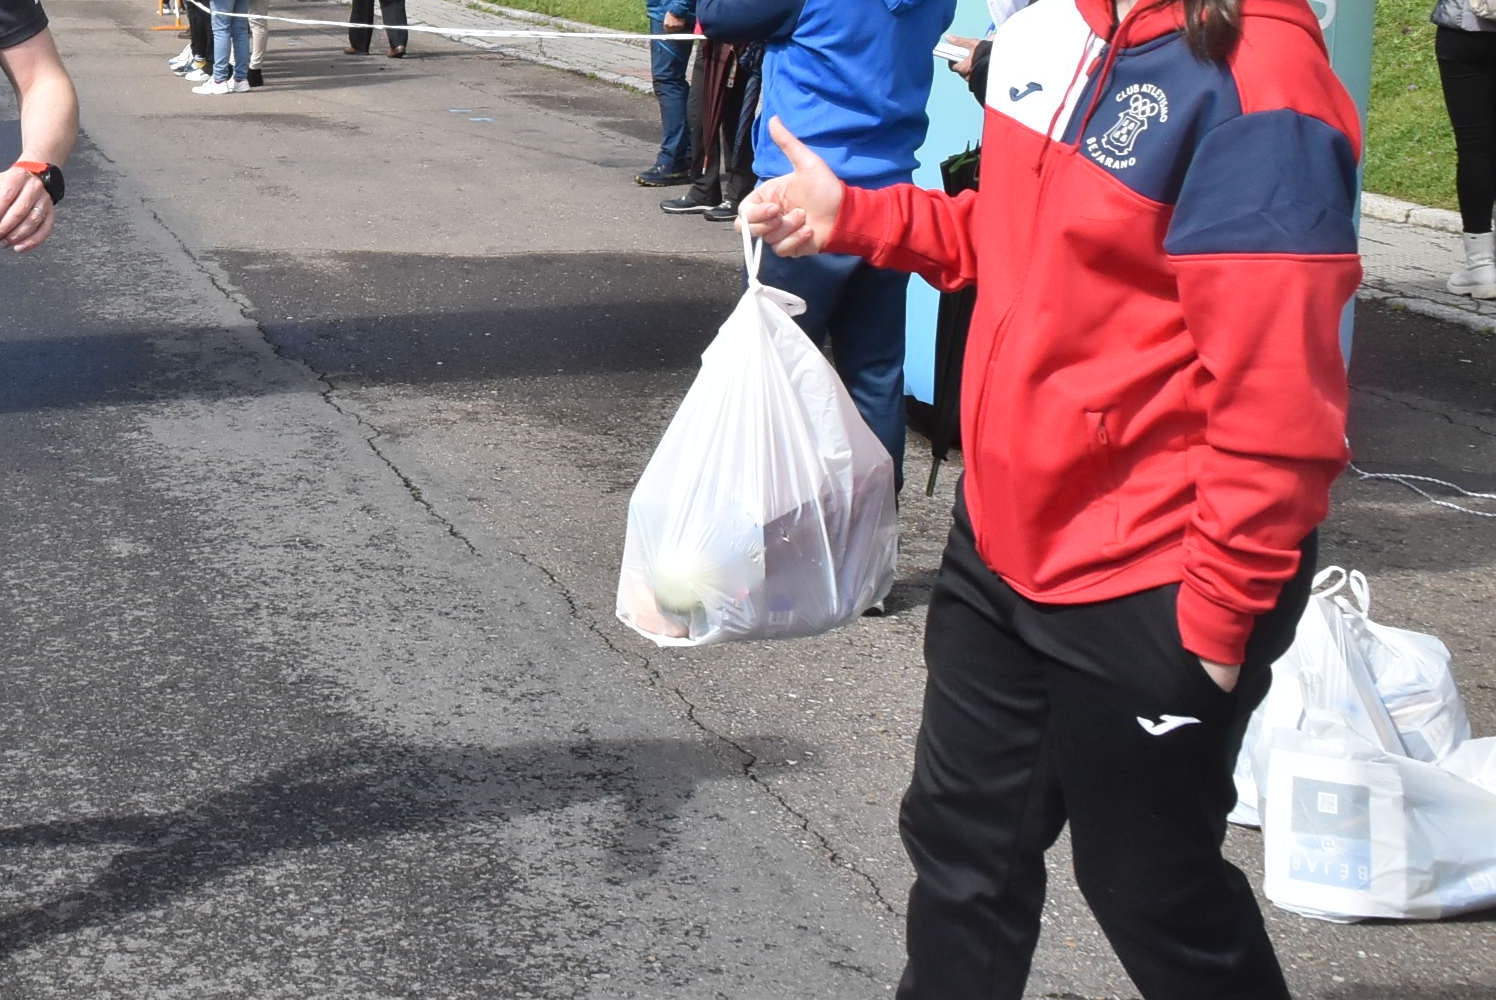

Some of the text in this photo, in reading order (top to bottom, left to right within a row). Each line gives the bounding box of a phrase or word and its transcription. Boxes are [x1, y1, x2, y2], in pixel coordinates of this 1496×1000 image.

[1115, 83, 1169, 123] CLUB ATLETISMO
[1086, 136, 1137, 170] BEJARANO
